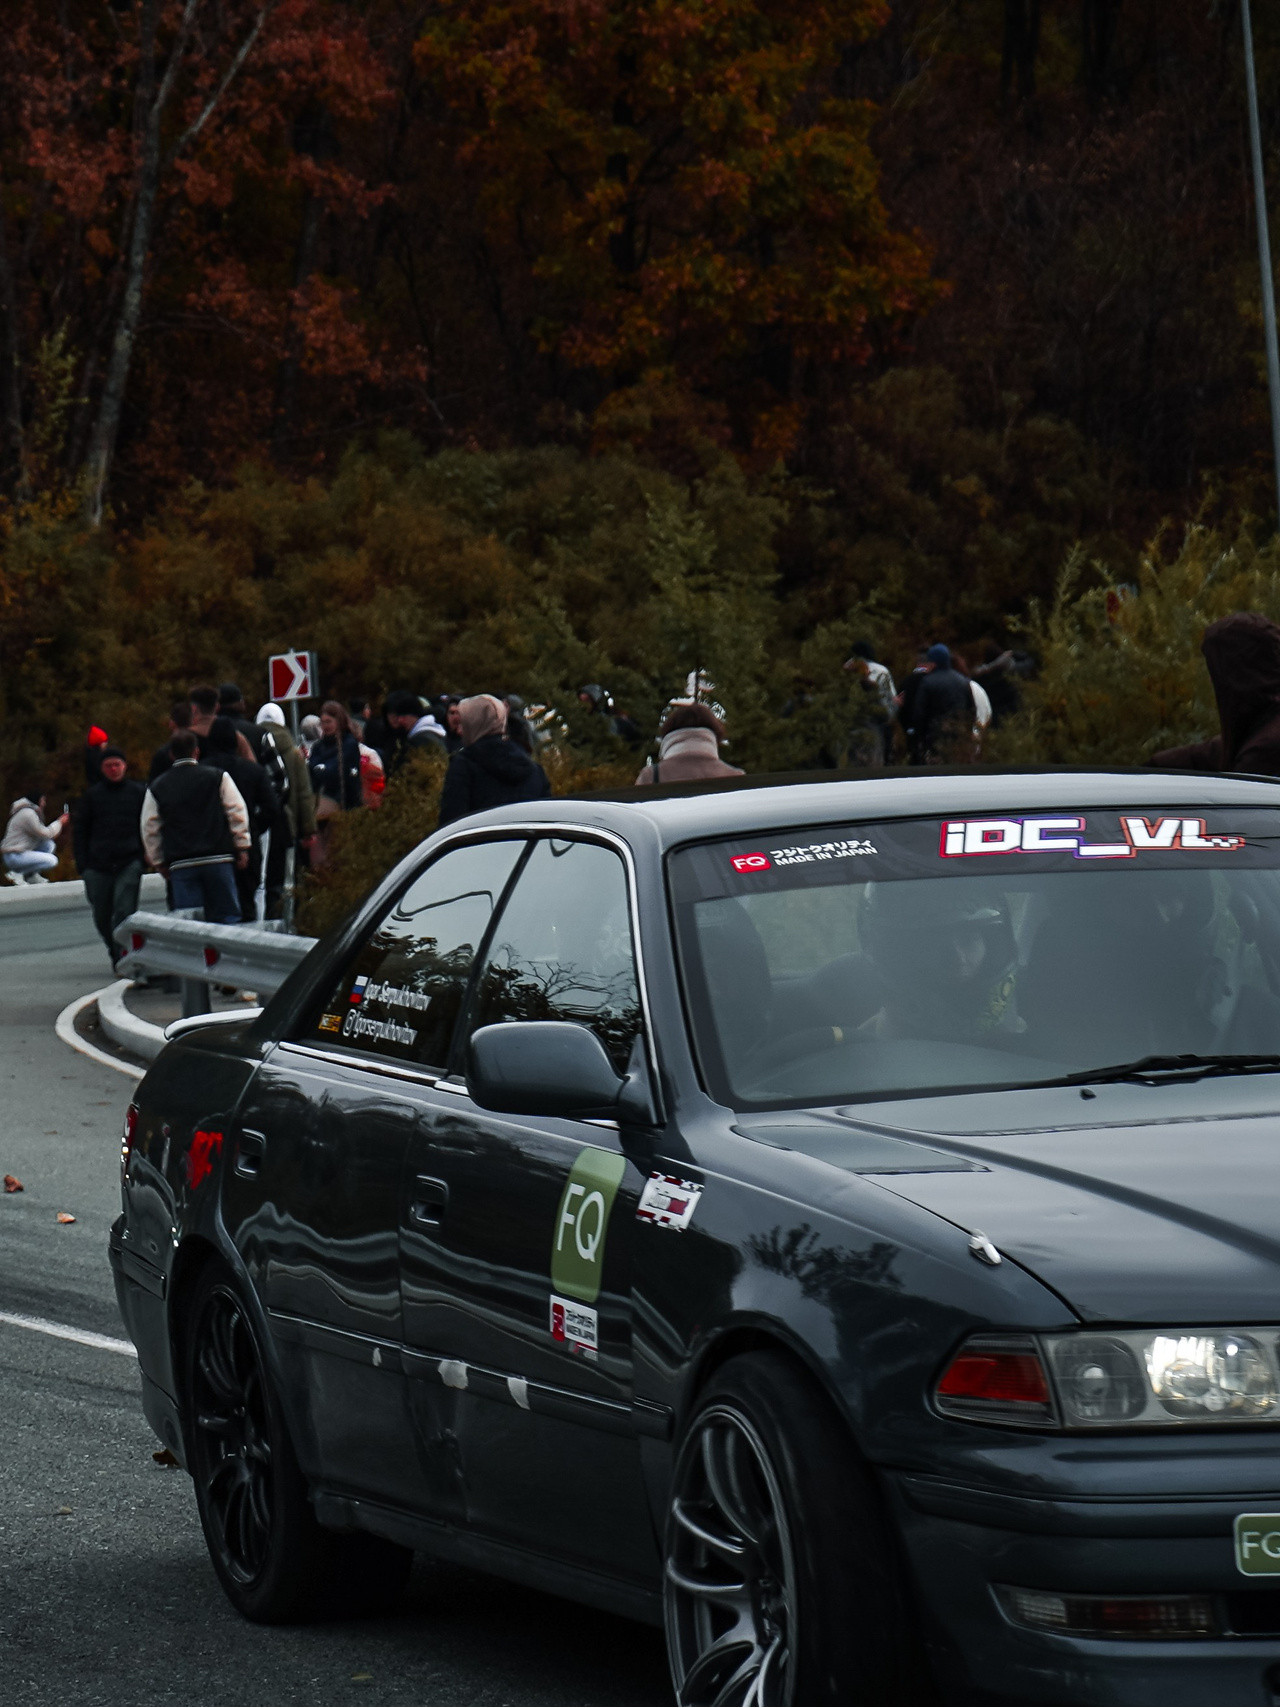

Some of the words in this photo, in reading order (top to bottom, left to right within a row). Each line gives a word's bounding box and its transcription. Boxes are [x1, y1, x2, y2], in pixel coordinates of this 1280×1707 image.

[733, 856, 766, 869] FQ
[774, 854, 815, 866] MADE
[816, 851, 832, 860] IN
[834, 846, 878, 858] JAPAN
[557, 1182, 605, 1263] FQ
